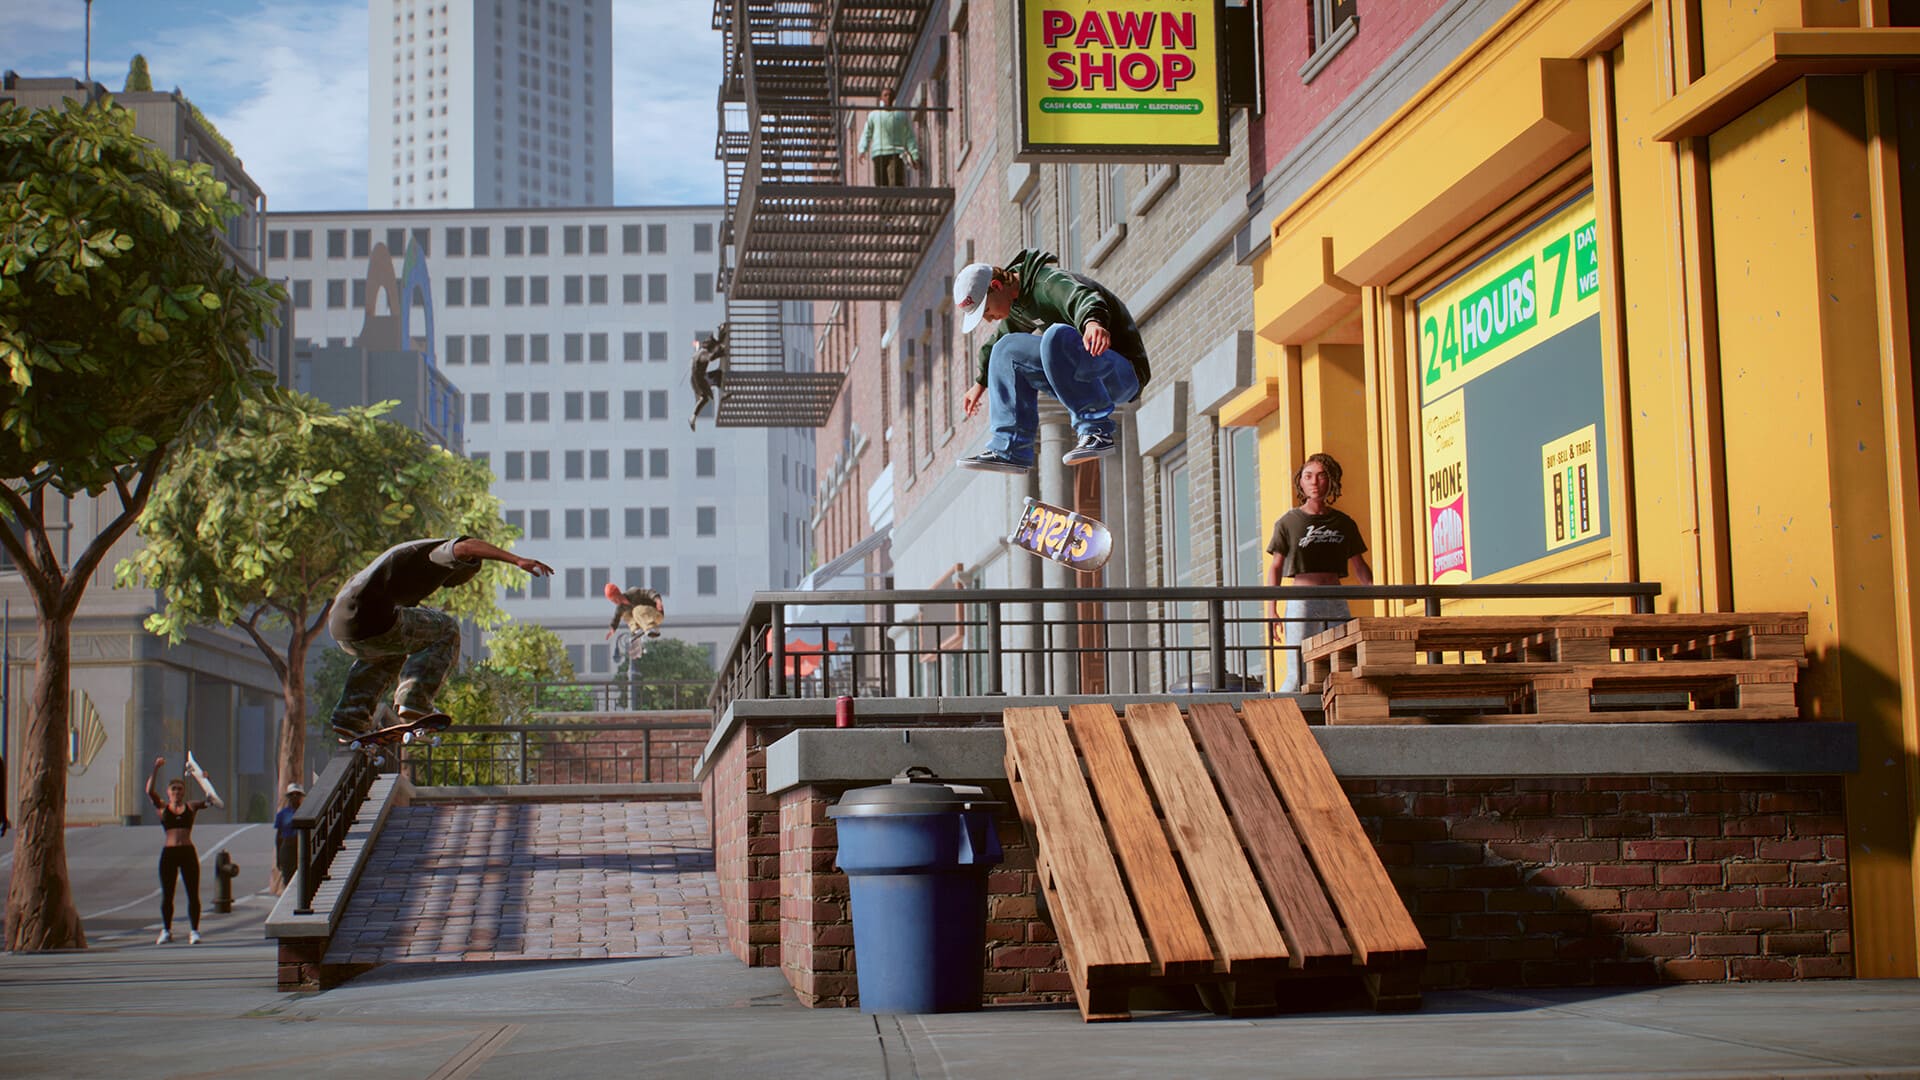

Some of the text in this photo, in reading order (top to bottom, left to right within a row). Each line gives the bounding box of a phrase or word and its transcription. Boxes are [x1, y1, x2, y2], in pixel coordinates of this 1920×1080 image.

[1042, 10, 1197, 50] PAWN
[1047, 51, 1196, 91] SHOP
[1072, 102, 1093, 110] GOLD
[1101, 102, 1140, 110] JEWELLERY
[1148, 103, 1199, 111] ELECTRONIC'S
[1589, 249, 1598, 265] A
[1424, 232, 1571, 386] 24 HOURS 7
[1547, 455, 1556, 469] BUY
[1569, 443, 1575, 460] &
[1576, 439, 1592, 457] TRADE
[1429, 461, 1463, 505] PHONE
[1433, 507, 1464, 557] REPAIR
